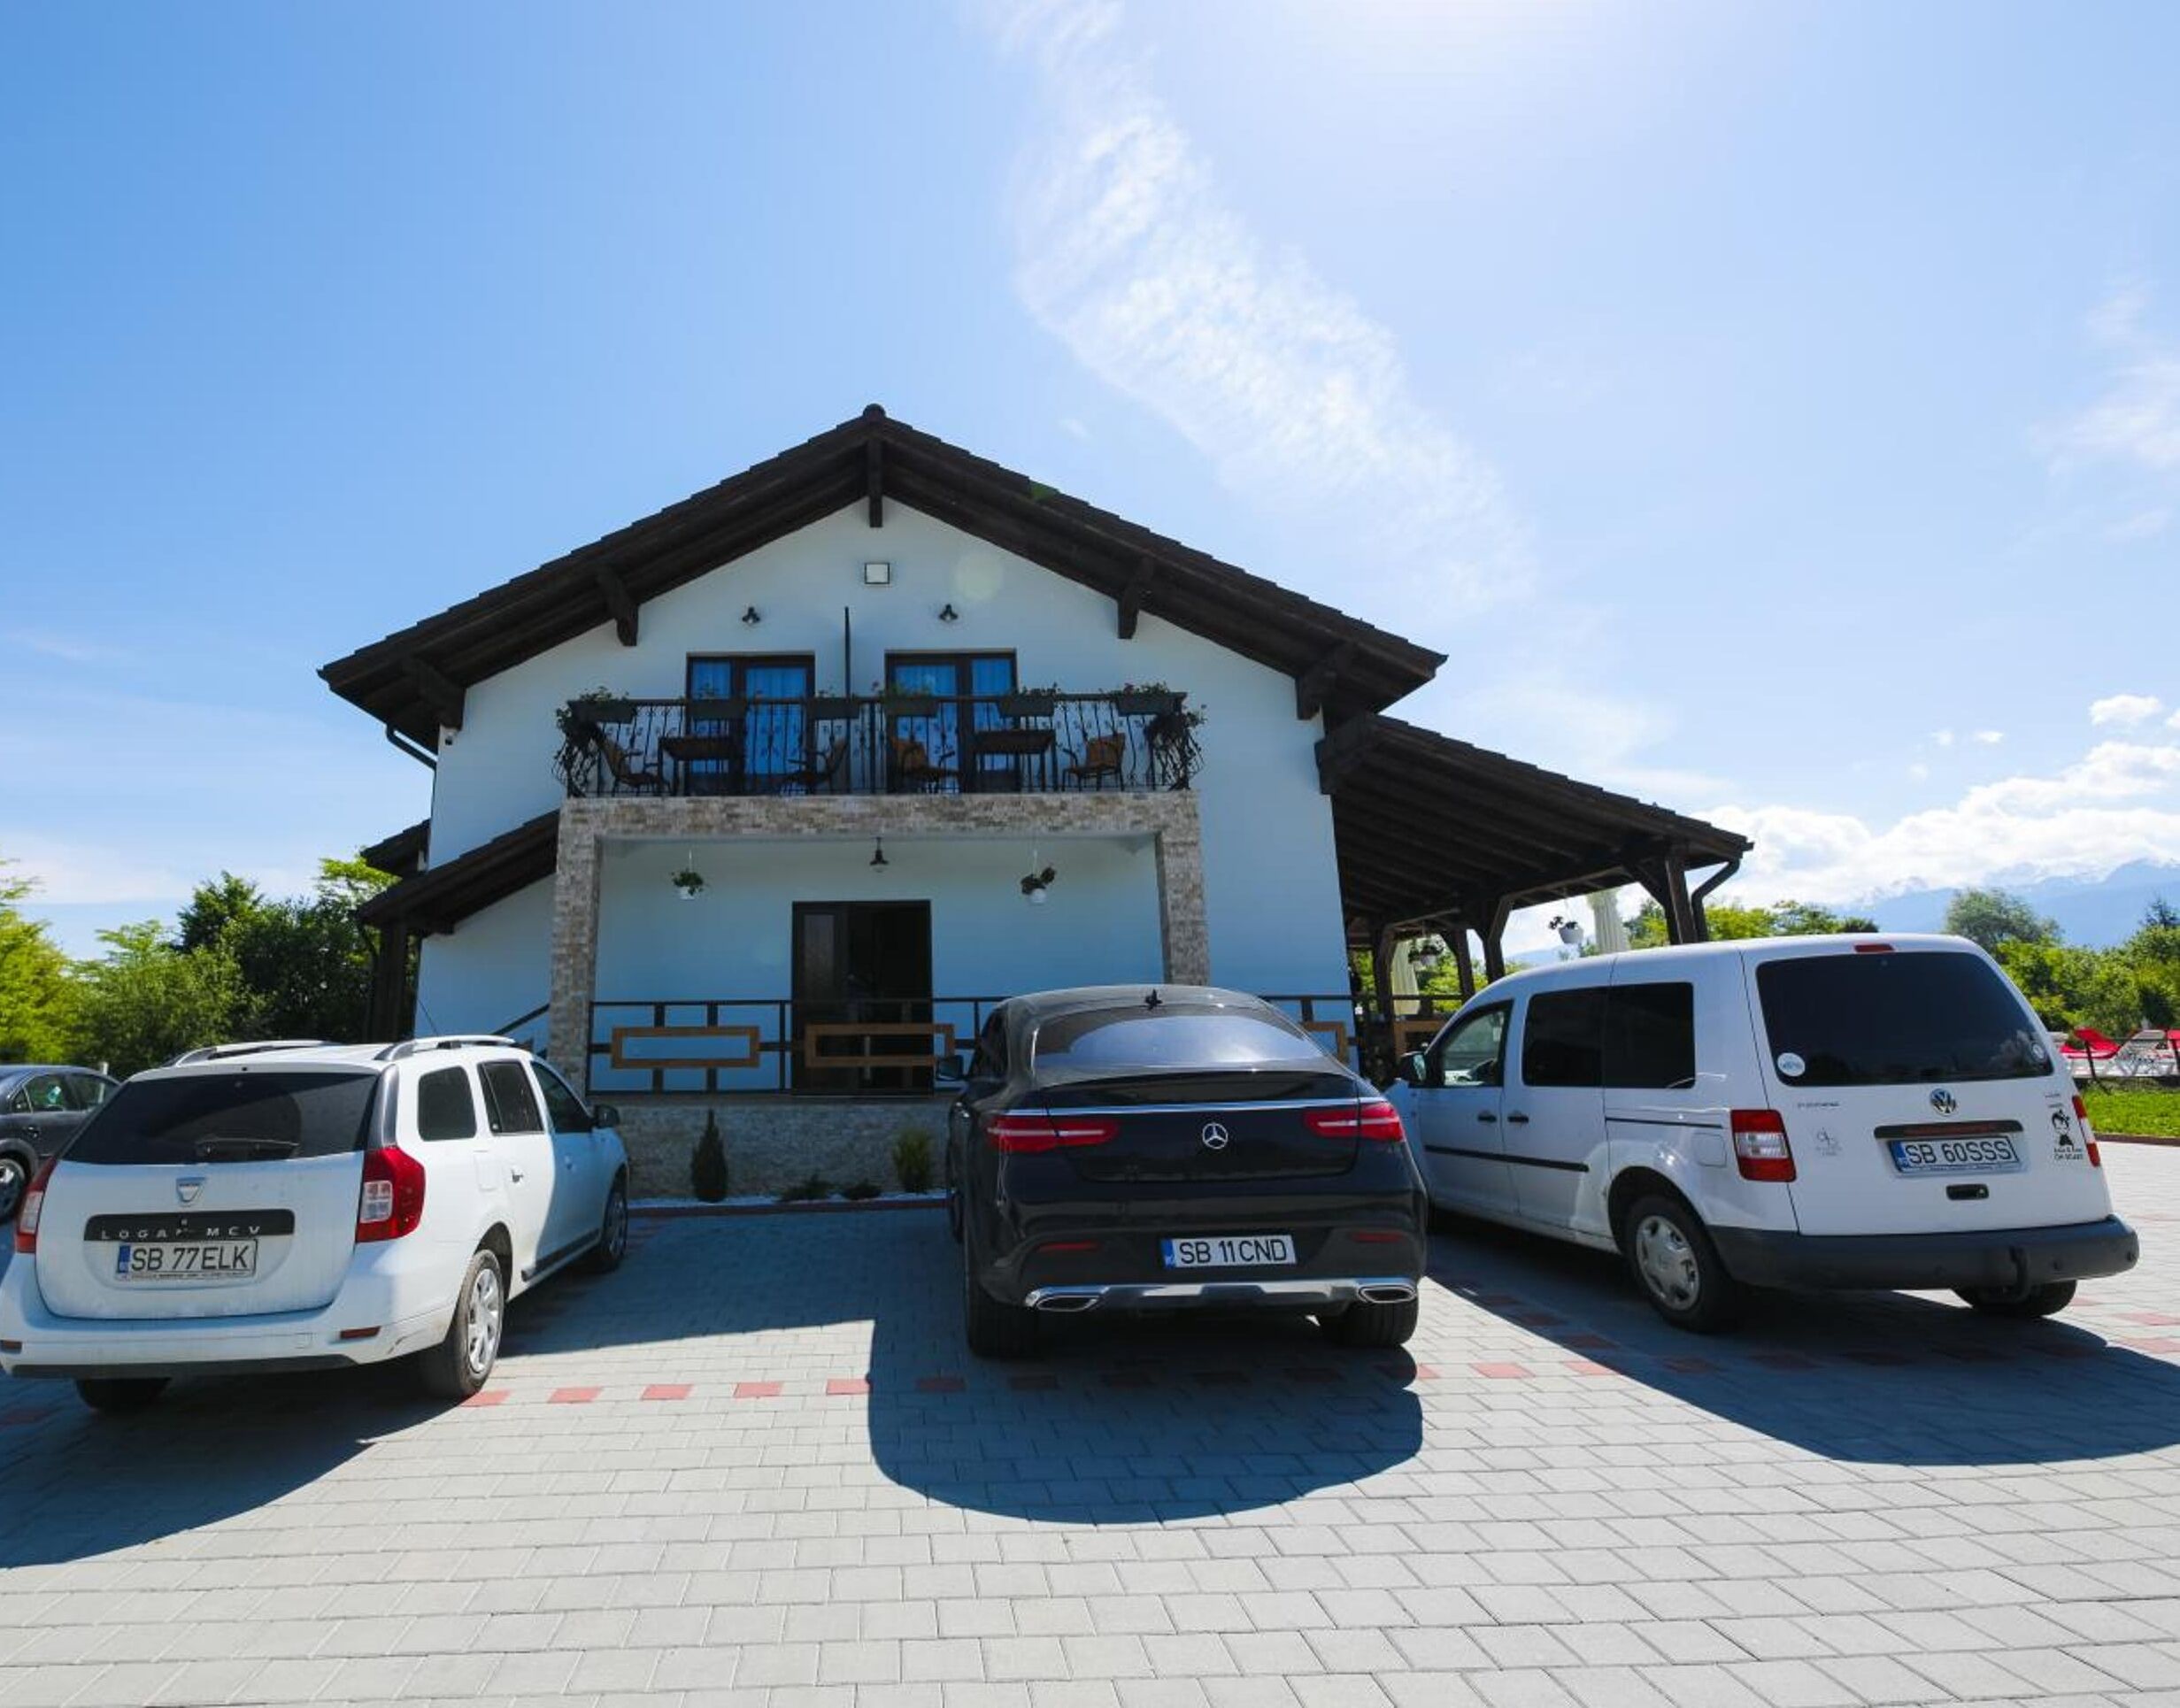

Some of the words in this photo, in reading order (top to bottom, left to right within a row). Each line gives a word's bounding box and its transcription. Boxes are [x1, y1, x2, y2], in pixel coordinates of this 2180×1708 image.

[1905, 1144, 1937, 1164] SB
[1941, 1141, 2012, 1163] 60SSS
[206, 1226, 260, 1236] MCV
[131, 1248, 164, 1271] SB
[172, 1246, 249, 1271] 77ELK
[1179, 1242, 1211, 1264] SB
[1219, 1240, 1287, 1263] 11CND
